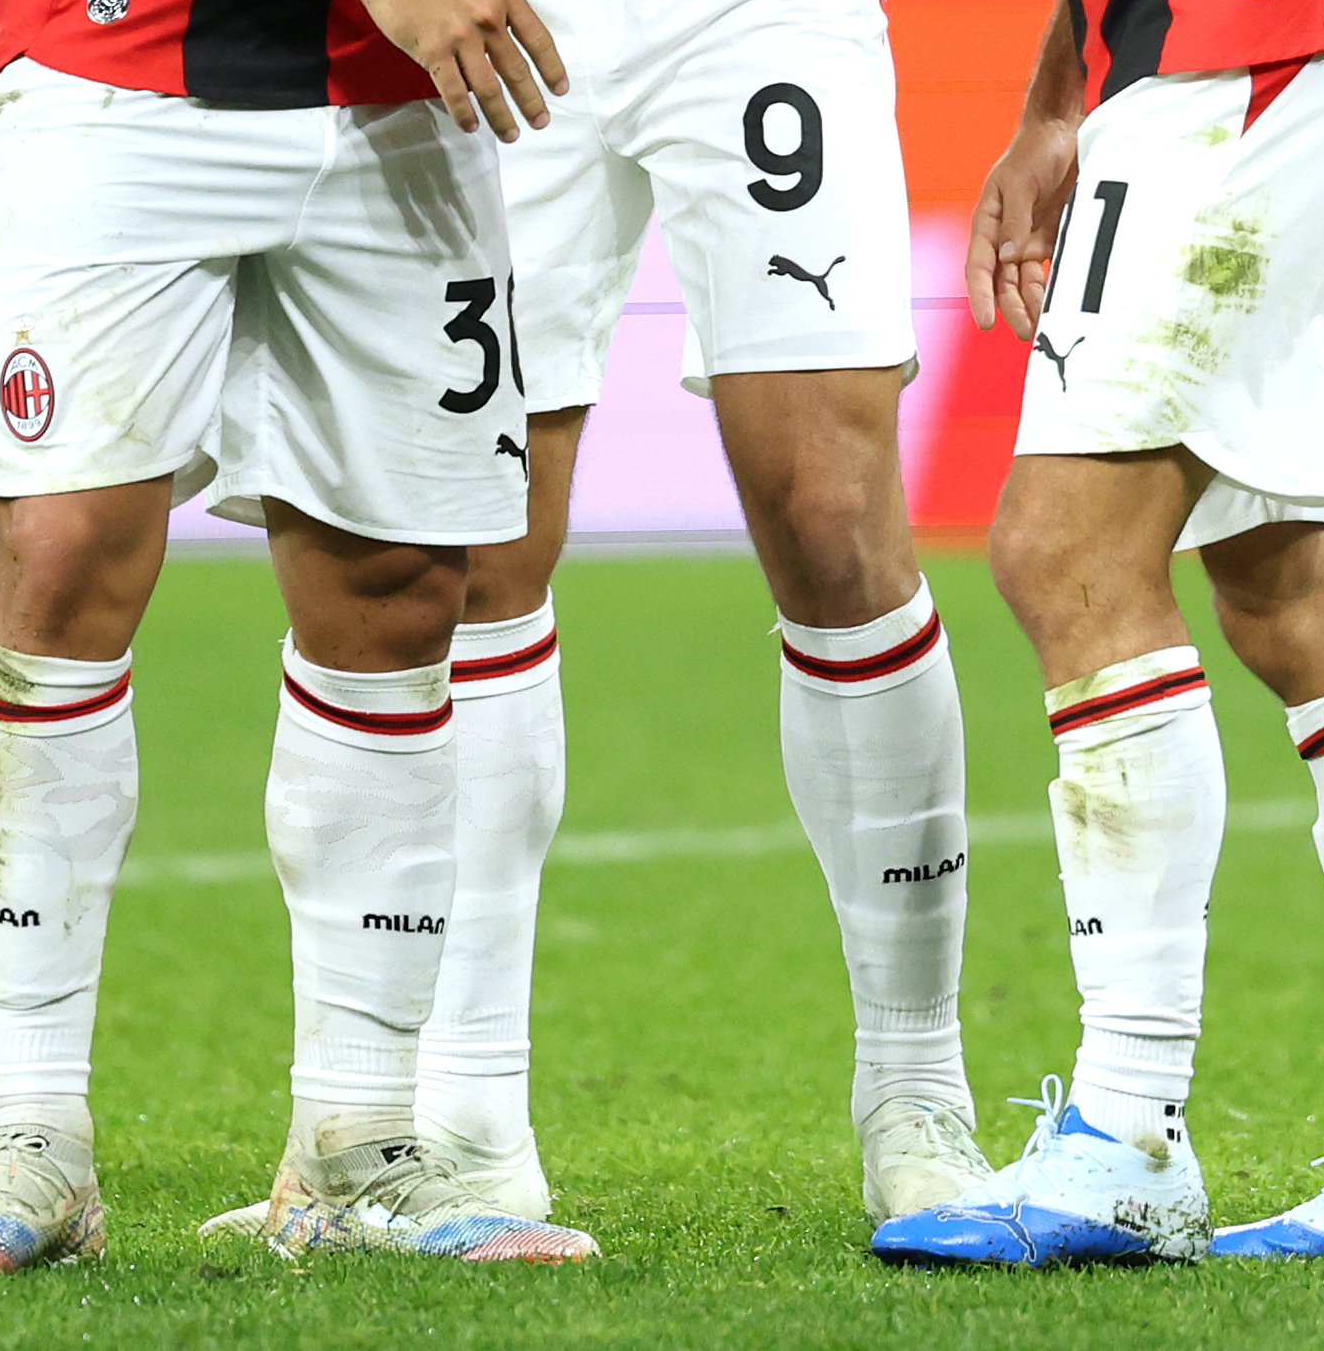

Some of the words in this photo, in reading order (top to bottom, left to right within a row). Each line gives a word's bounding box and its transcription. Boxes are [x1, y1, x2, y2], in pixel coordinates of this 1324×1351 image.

[743, 82, 823, 212] 9
[10, 356, 38, 373] ACM
[17, 420, 41, 430] 1899
